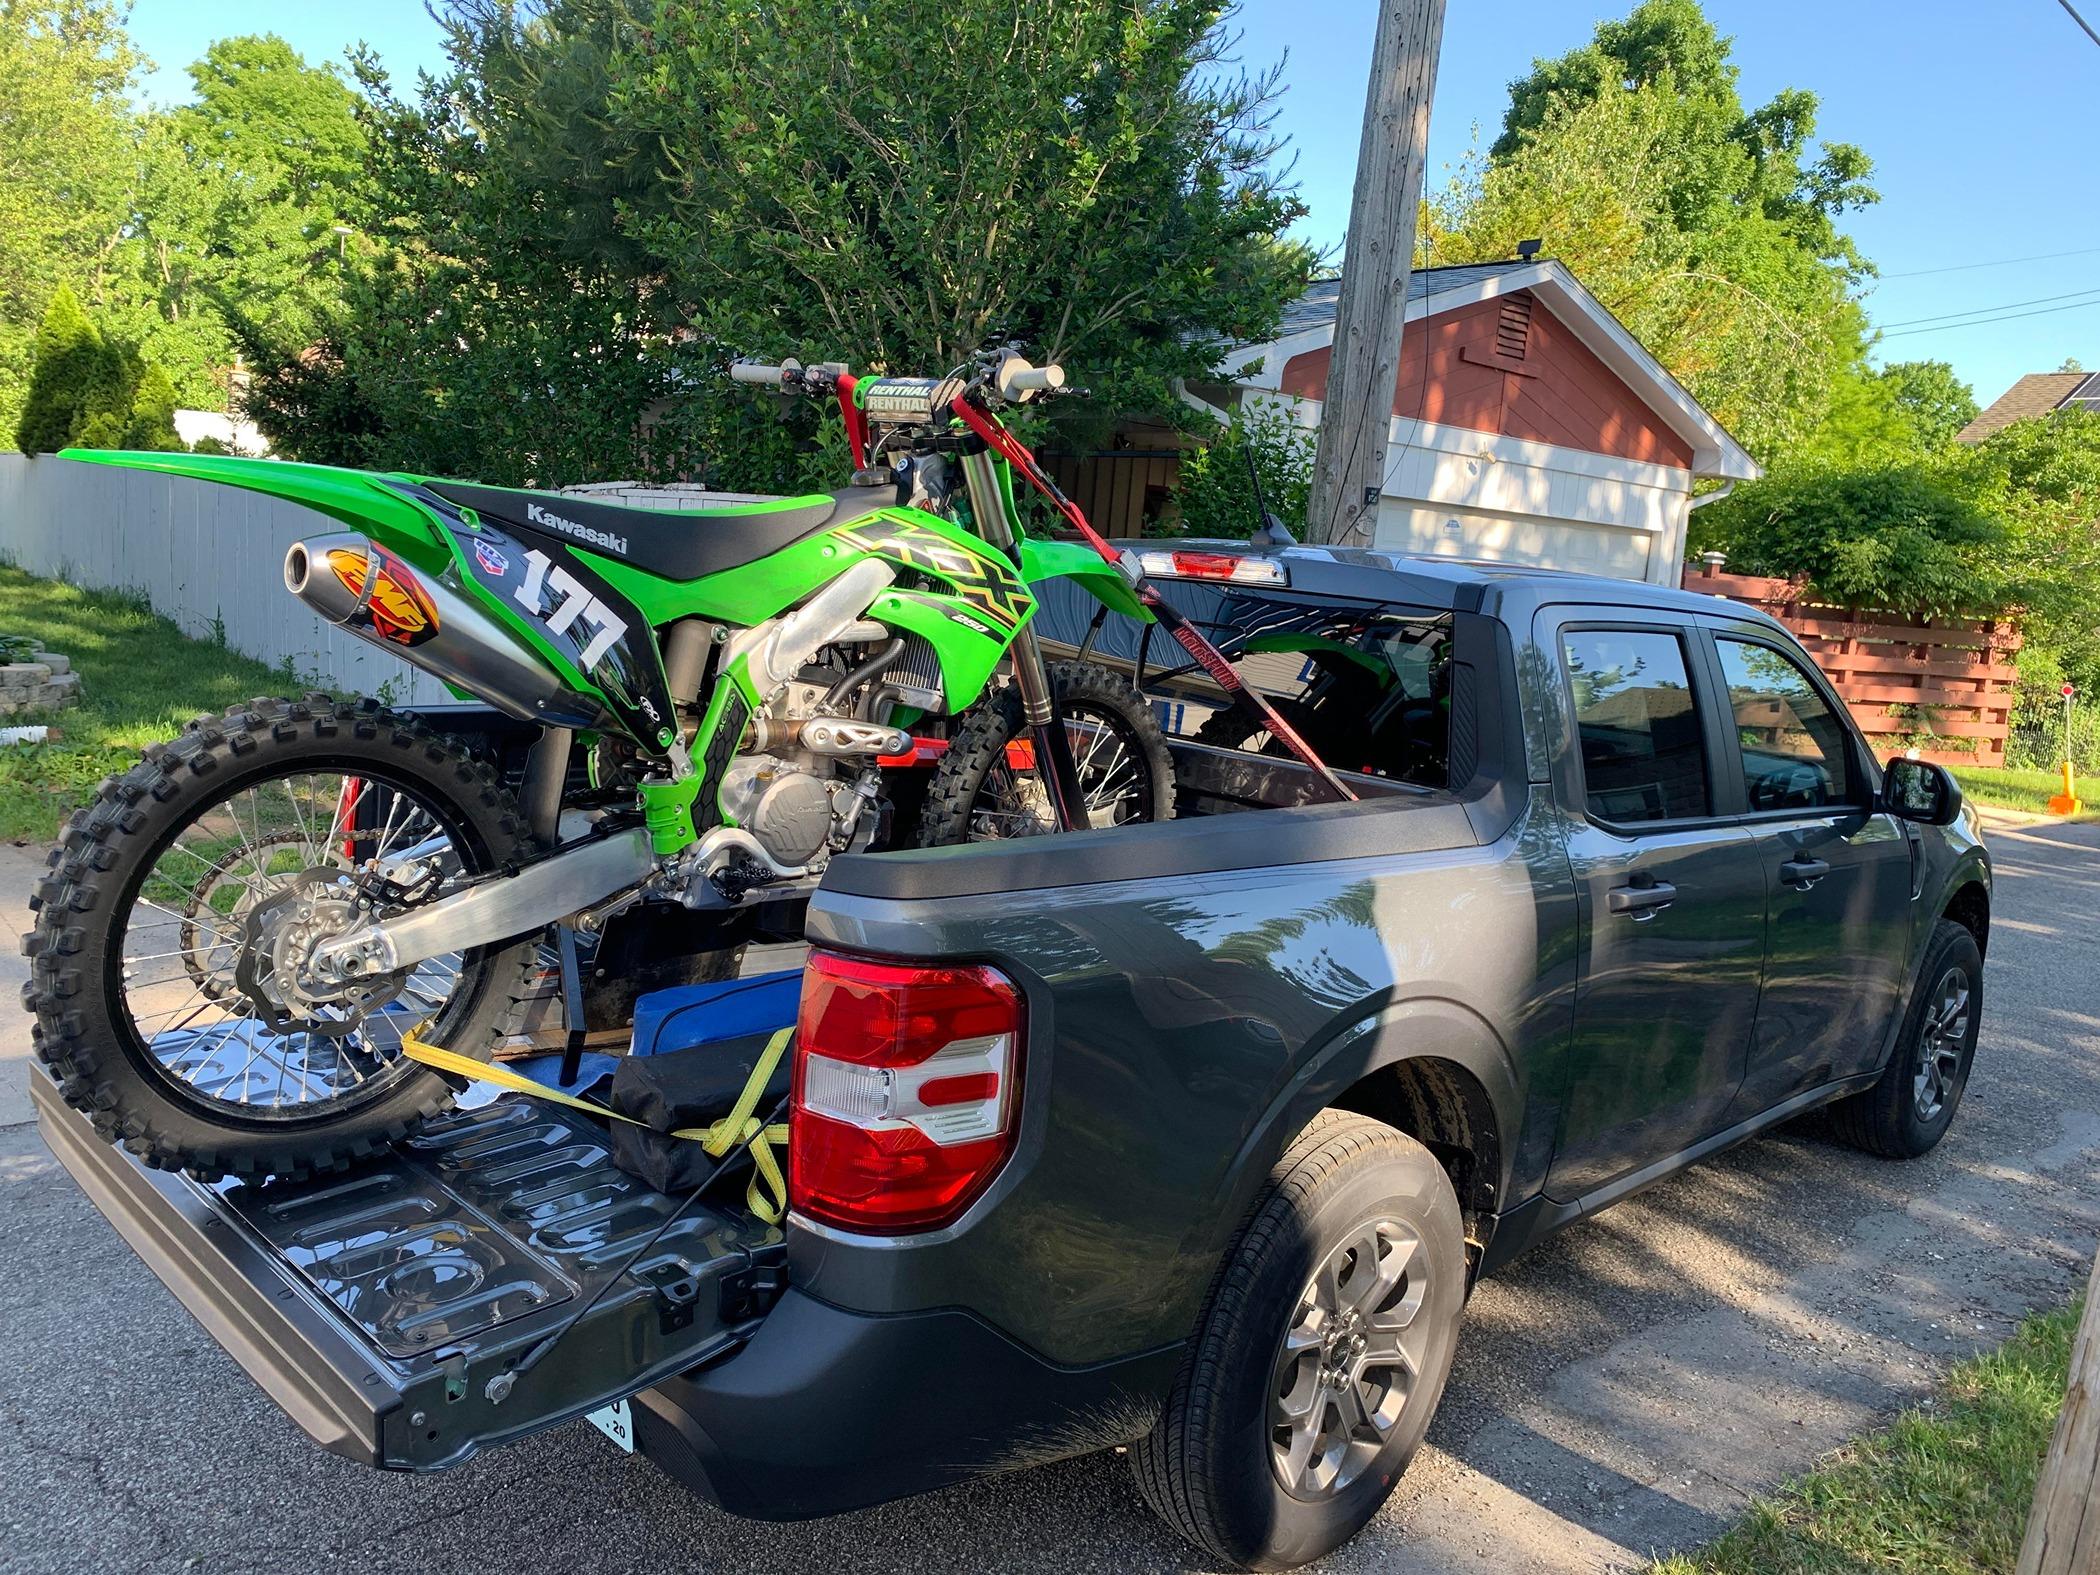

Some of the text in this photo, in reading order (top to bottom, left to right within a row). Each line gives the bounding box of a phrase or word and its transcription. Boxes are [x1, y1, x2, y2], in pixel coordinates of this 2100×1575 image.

[868, 385, 931, 396] RENTHAL
[868, 398, 929, 411] RENTHAL
[527, 503, 628, 555] Kawasaki
[513, 549, 629, 674] 177
[951, 613, 989, 632] 250
[613, 1420, 626, 1439] 20
